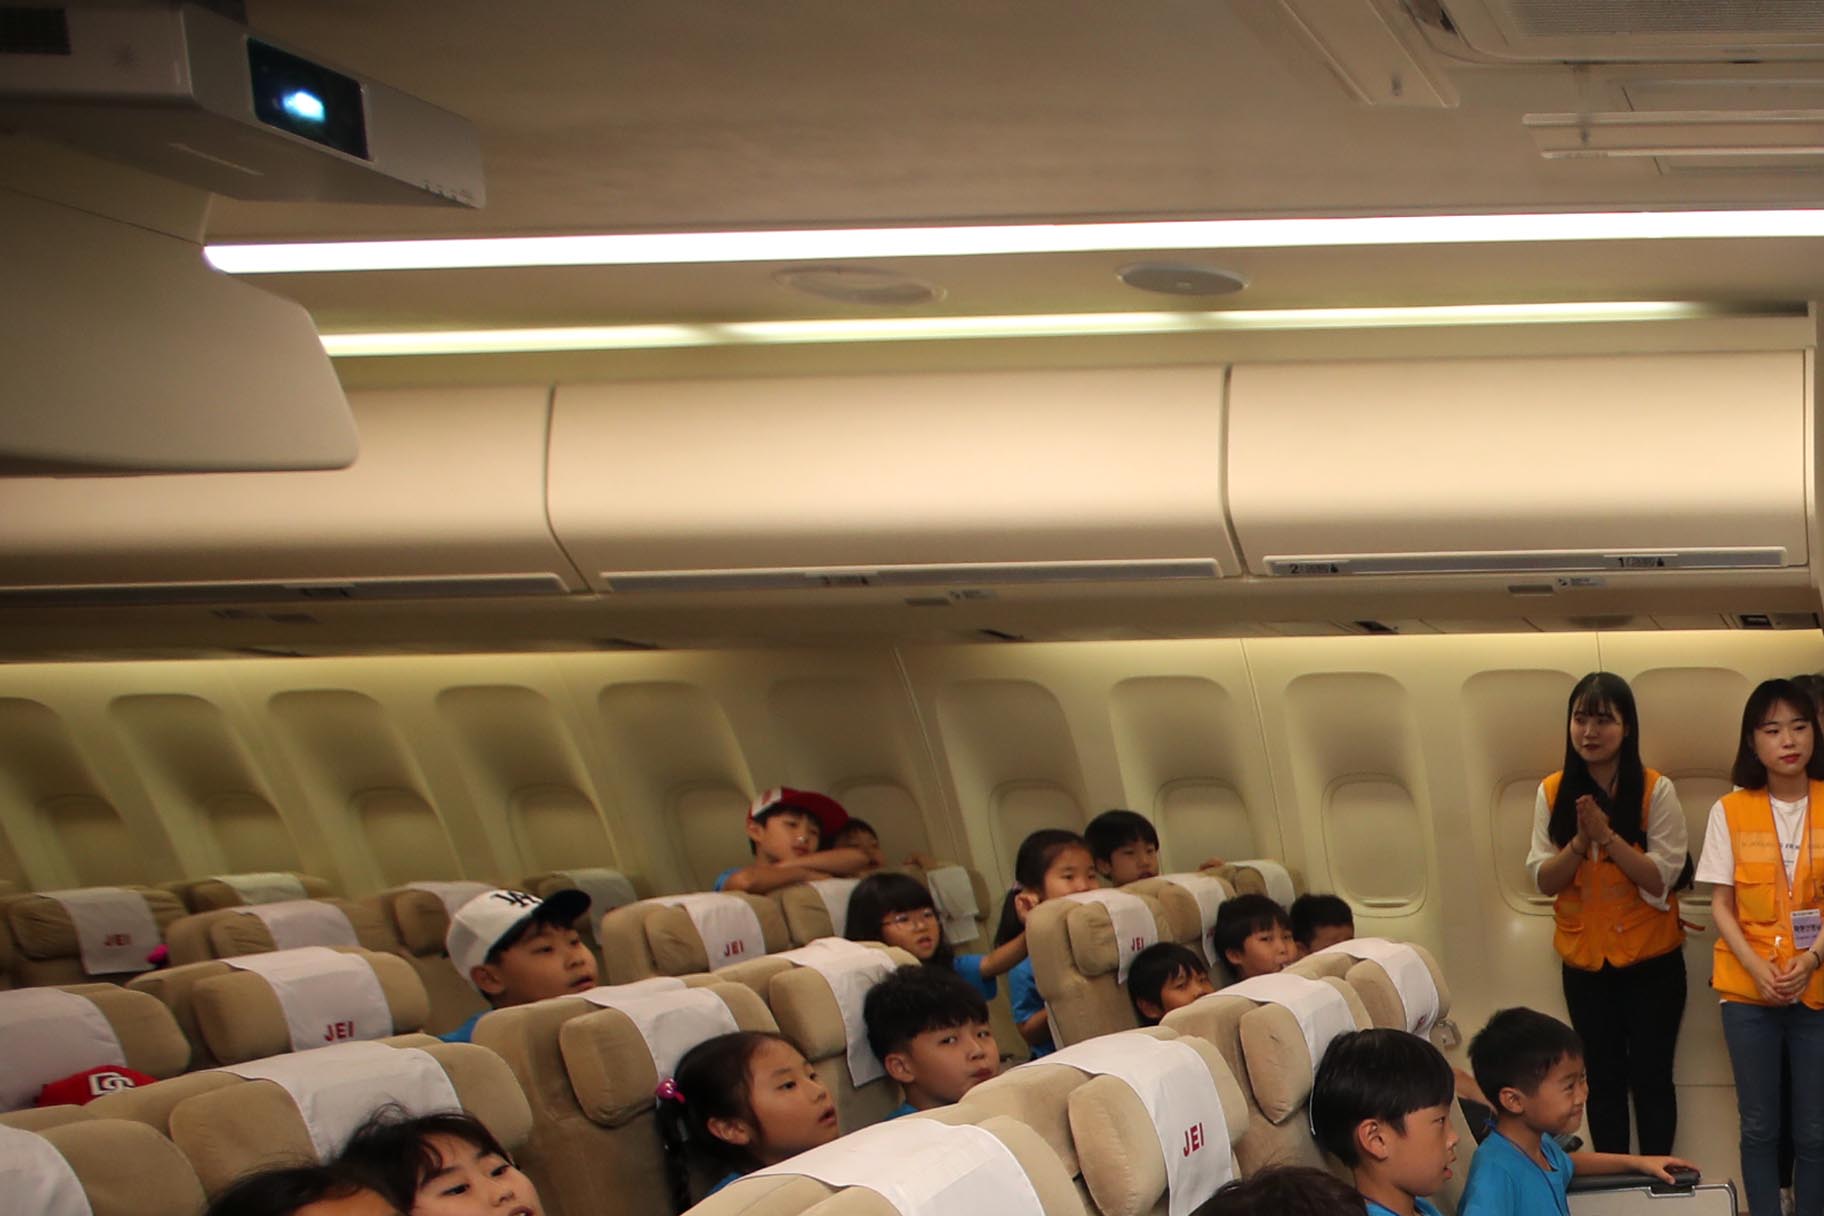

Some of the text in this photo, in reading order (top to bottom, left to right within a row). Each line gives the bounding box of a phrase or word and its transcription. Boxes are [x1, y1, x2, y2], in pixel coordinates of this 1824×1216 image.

[724, 939, 744, 957] JEI
[323, 1020, 355, 1042] JEI
[1183, 1122, 1205, 1158] JEI
